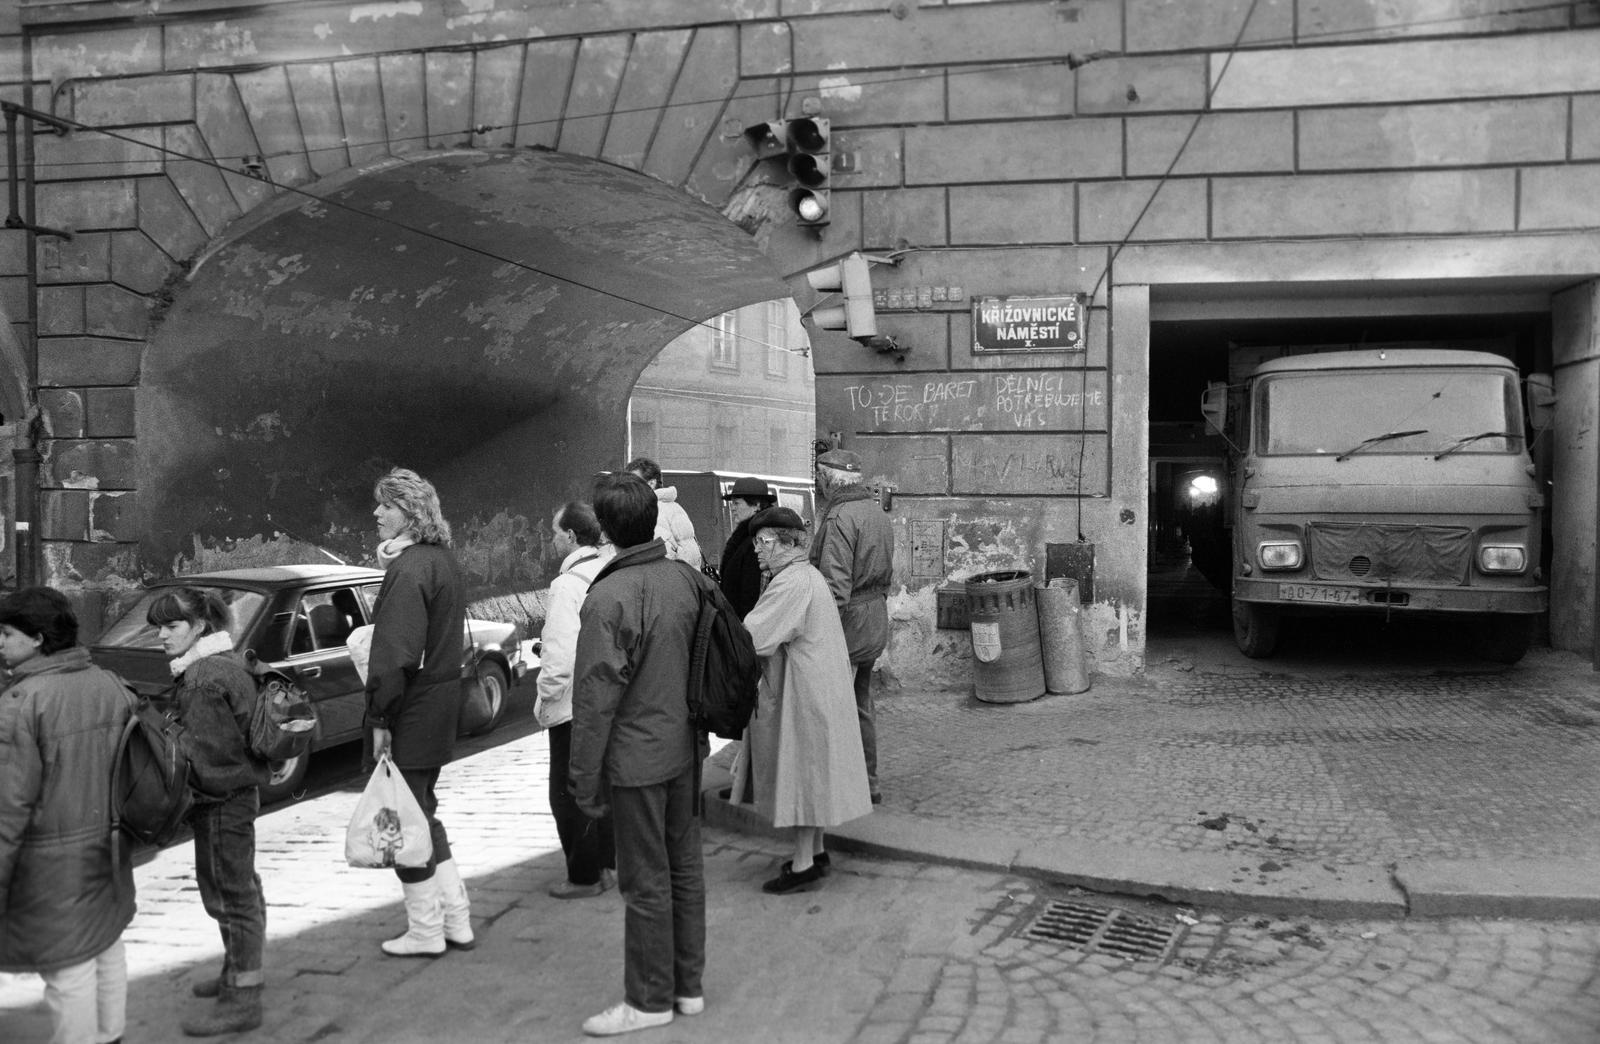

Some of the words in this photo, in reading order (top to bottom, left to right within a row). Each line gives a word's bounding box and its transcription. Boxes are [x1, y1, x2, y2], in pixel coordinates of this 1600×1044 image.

[981, 303, 1076, 324] KŘIŽOVNICKÉ
[996, 322, 1060, 340] NÁMĚSTÍ
[843, 384, 872, 411] TO
[923, 380, 978, 404] BARET
